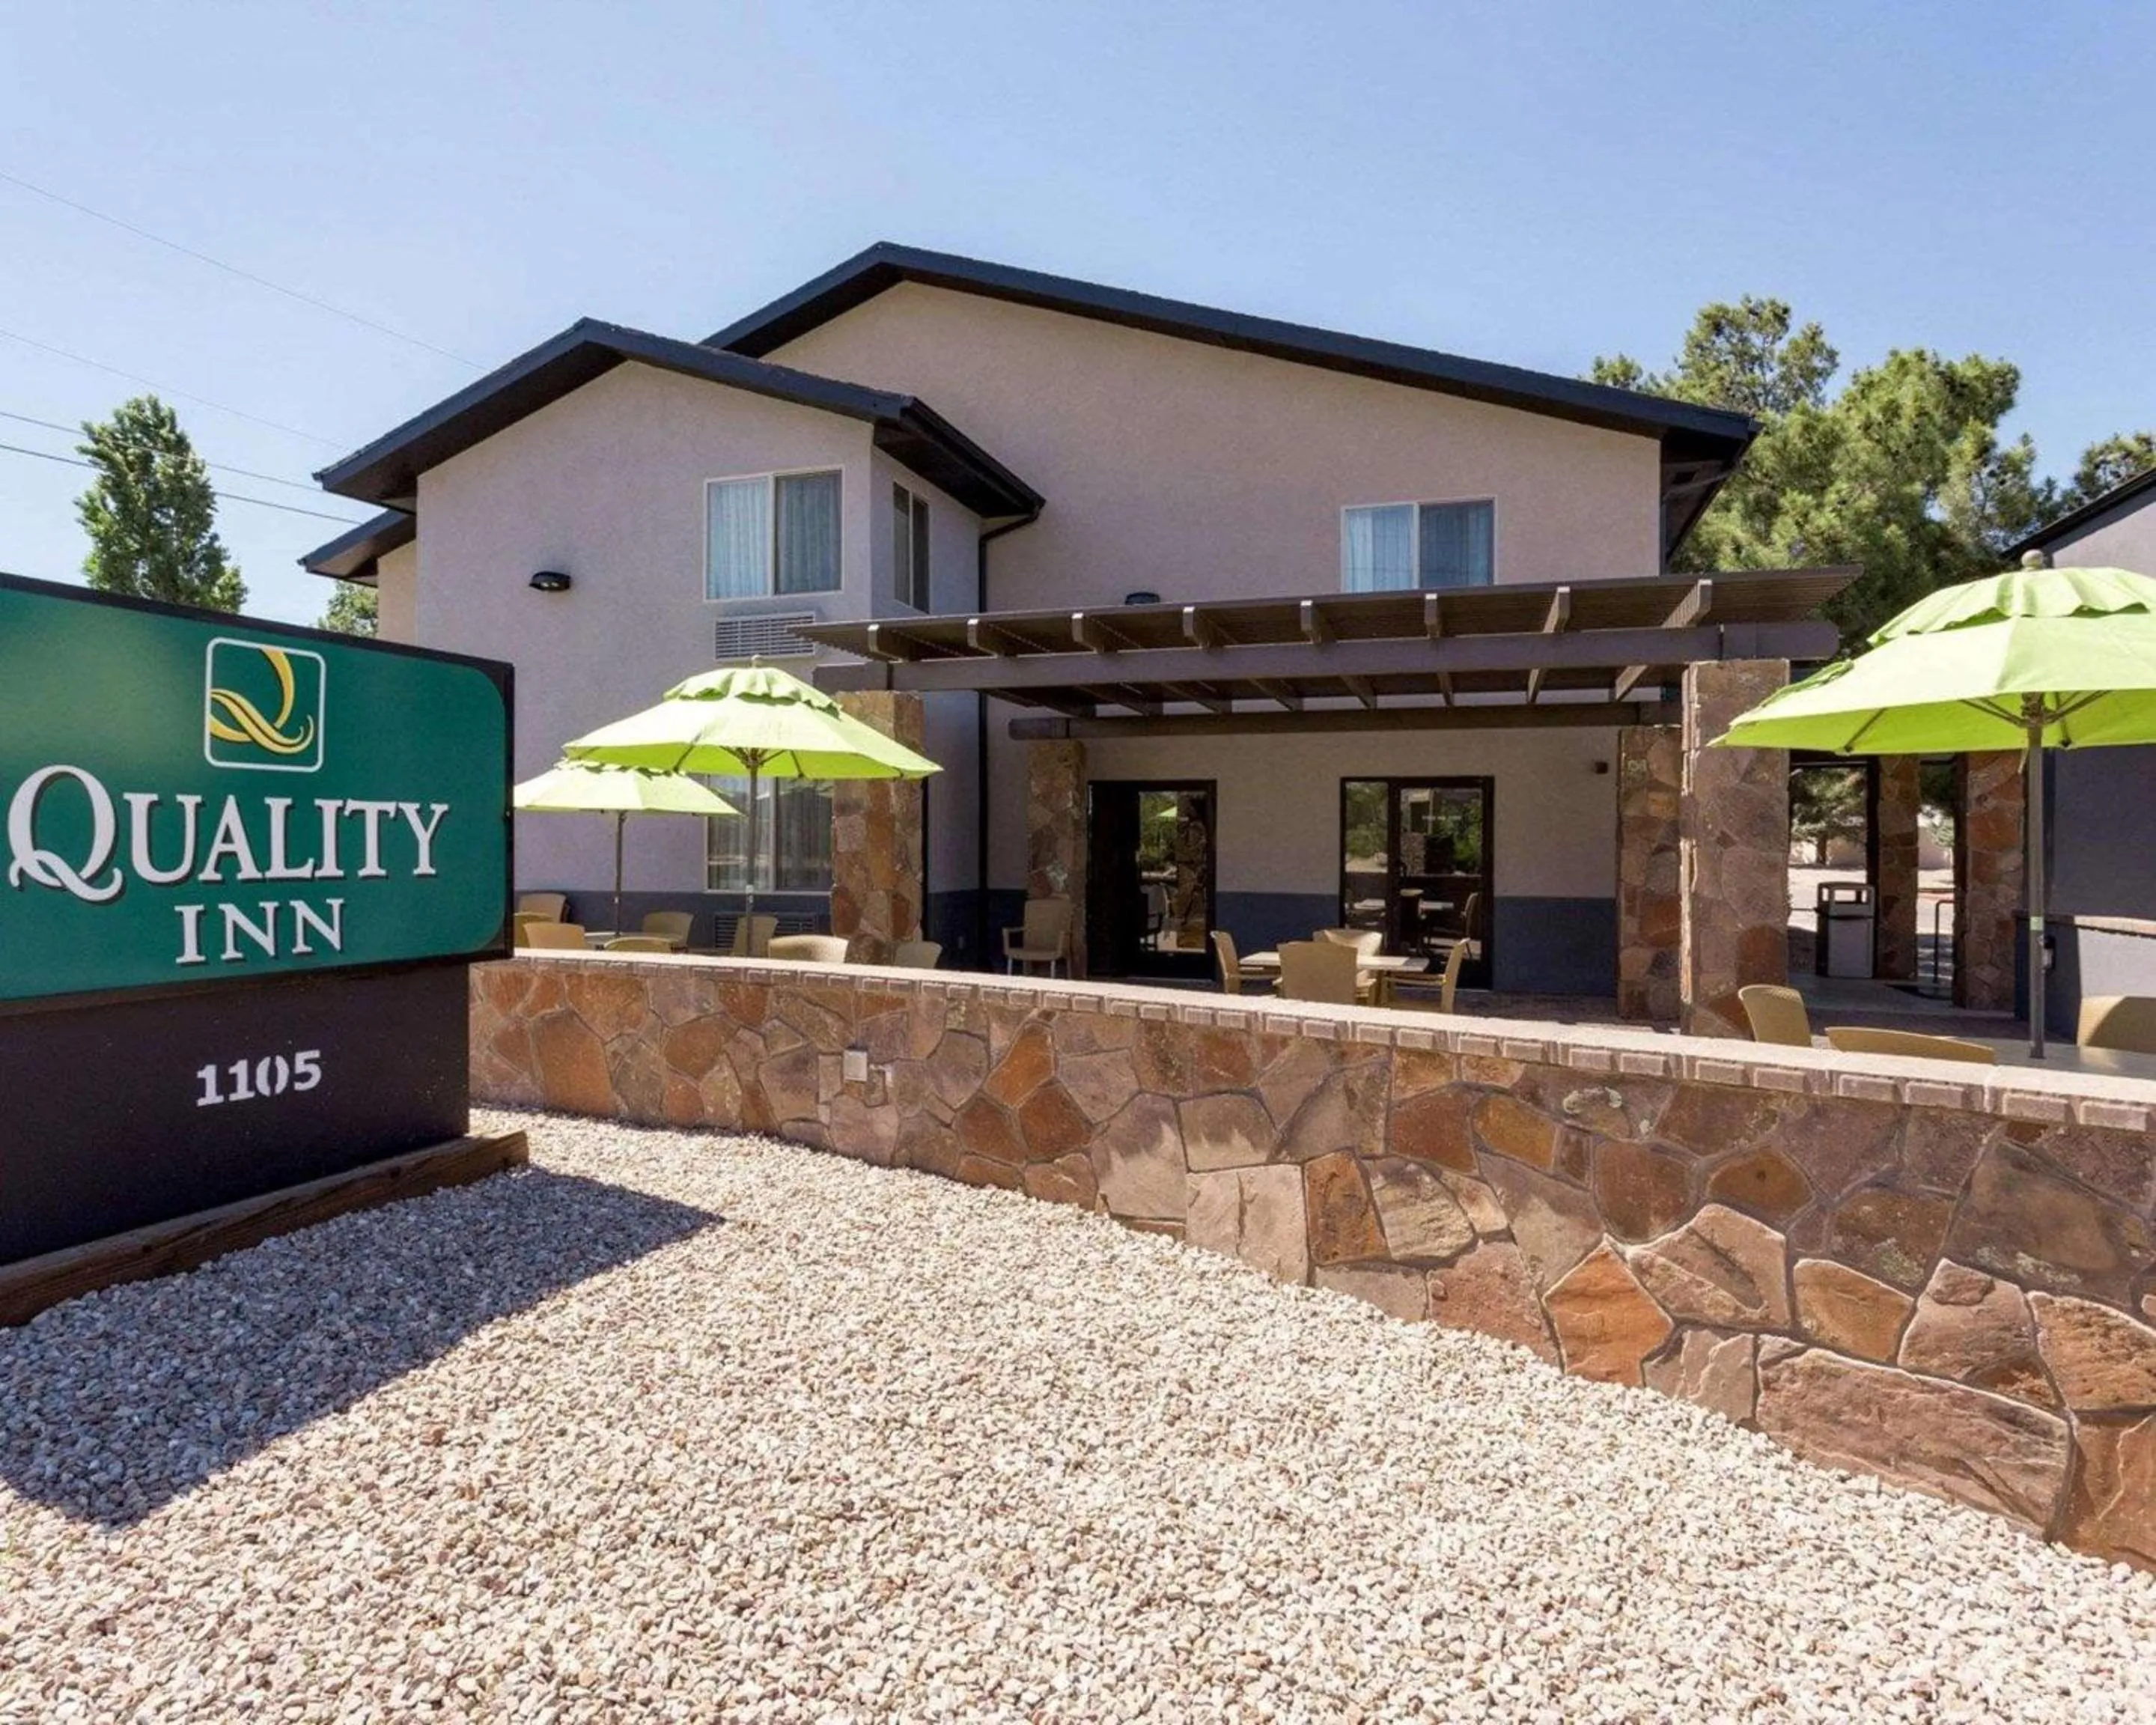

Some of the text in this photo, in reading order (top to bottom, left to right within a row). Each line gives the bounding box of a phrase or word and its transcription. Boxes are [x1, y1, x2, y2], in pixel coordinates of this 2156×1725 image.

[7, 764, 449, 901] QUALITY
[174, 898, 344, 964] INN
[196, 1049, 322, 1107] 1105
